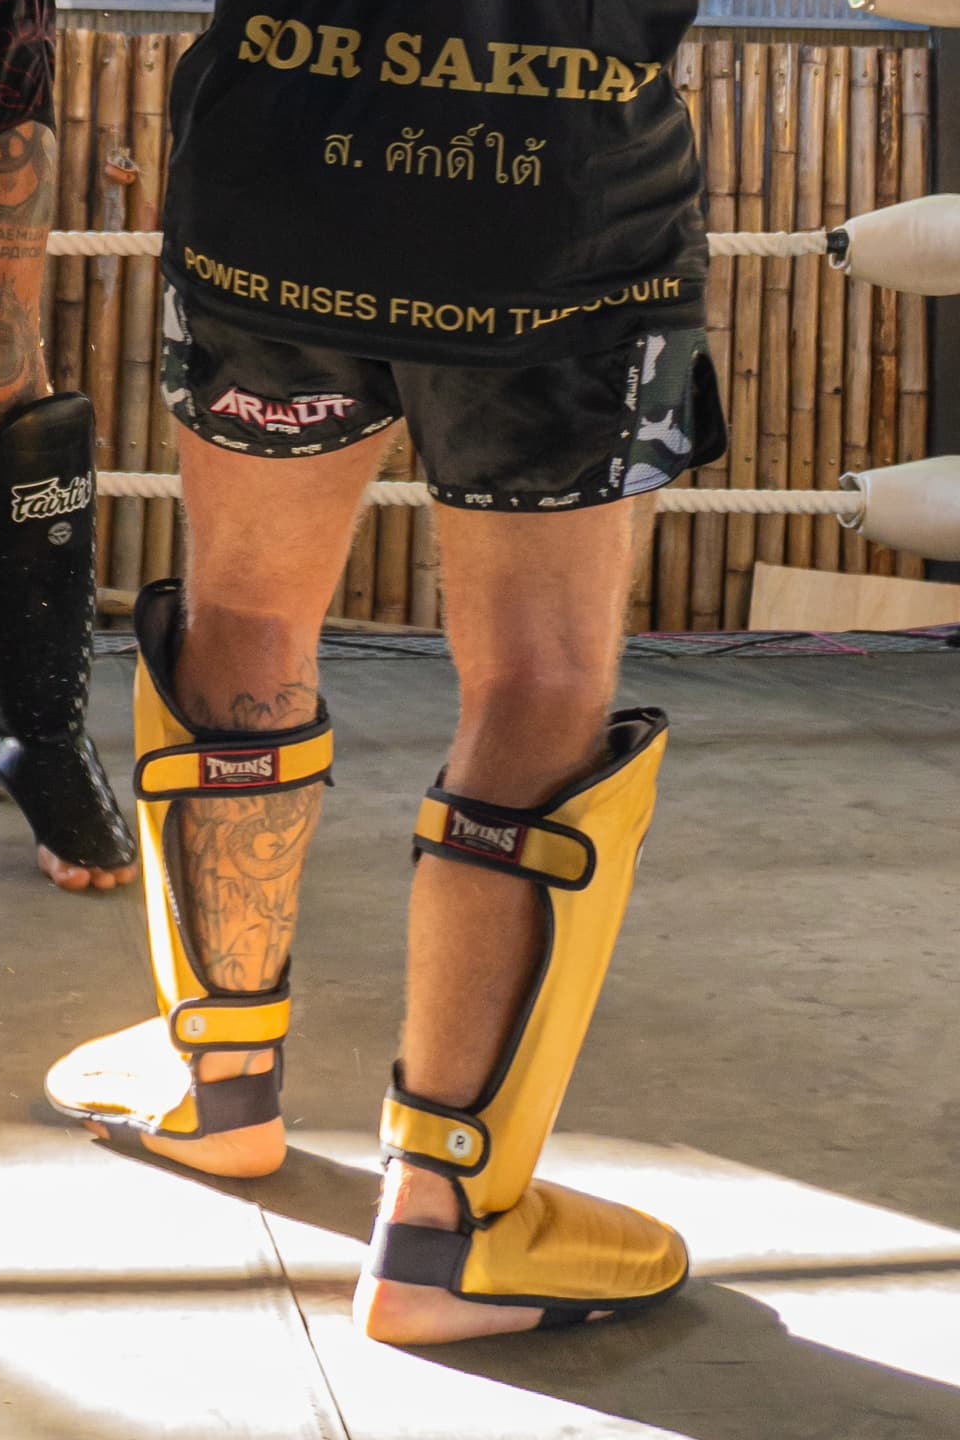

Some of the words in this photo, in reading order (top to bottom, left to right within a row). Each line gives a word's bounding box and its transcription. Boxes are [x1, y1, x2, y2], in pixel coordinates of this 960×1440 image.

[239, 14, 361, 79] SOR
[184, 246, 270, 303] POWER
[280, 280, 377, 321] RISES
[389, 297, 496, 335] FROM
[209, 387, 357, 428] ARWUT
[206, 753, 273, 779] TWINS
[451, 810, 519, 853] TWINS
